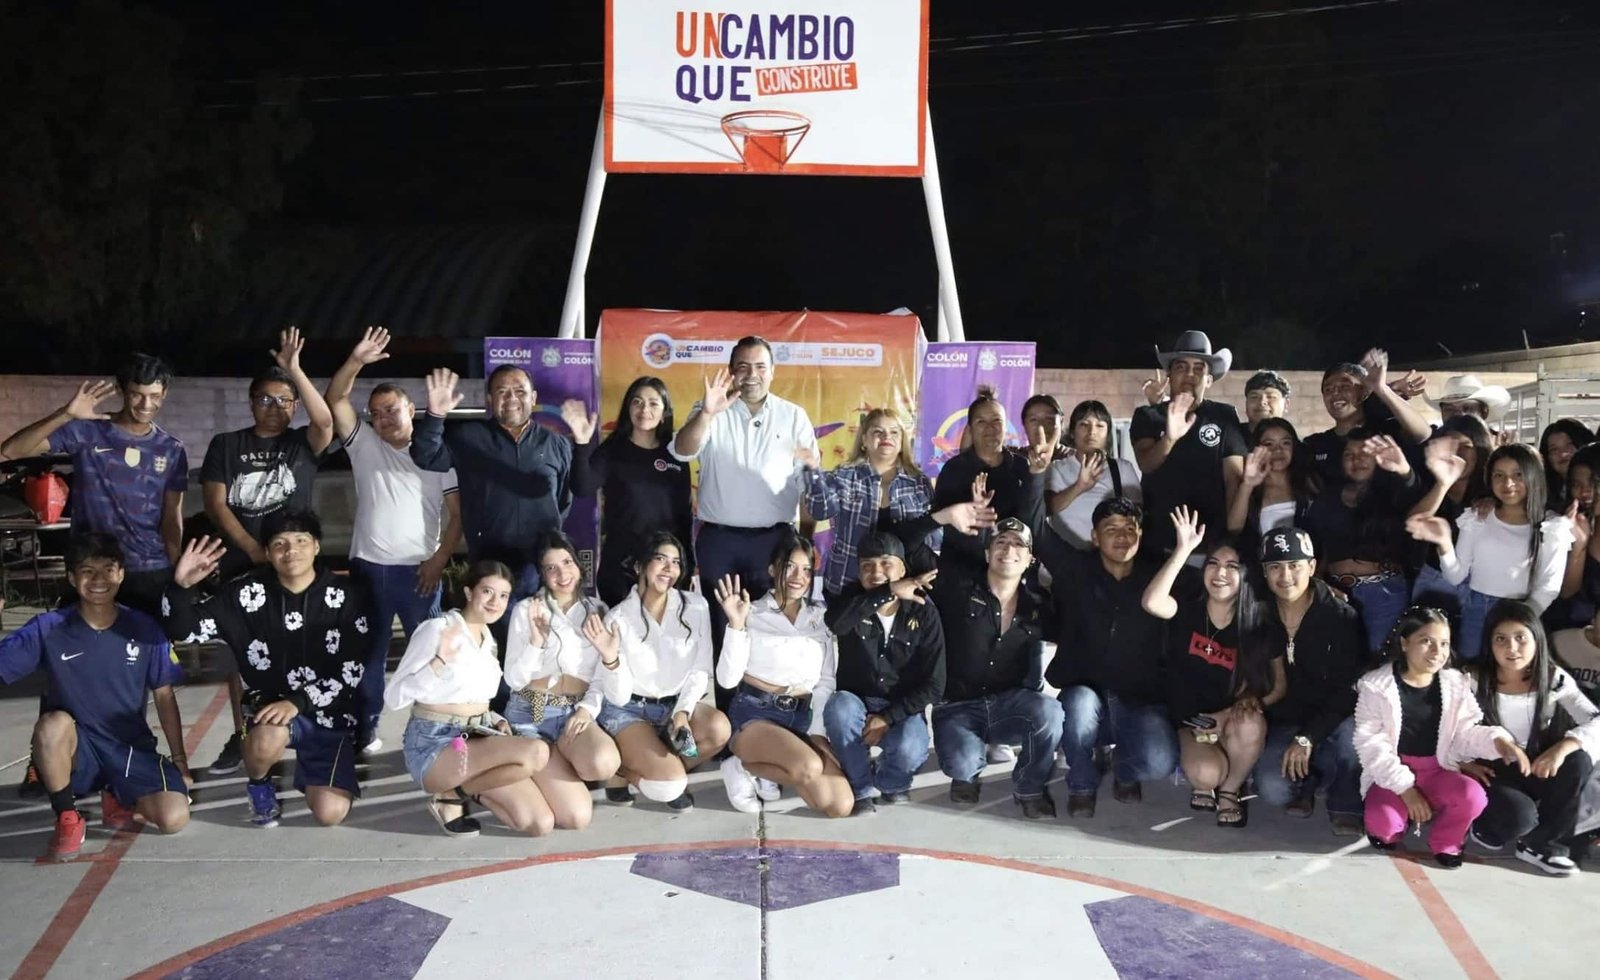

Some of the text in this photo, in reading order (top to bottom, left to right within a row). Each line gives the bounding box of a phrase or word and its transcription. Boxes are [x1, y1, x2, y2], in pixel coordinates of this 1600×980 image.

[676, 11, 855, 61] UN CAMBIO
[675, 64, 852, 104] QUE CONSTRUYE
[686, 345, 724, 353] CAMBIO
[821, 347, 875, 357] SEJUCO
[675, 351, 693, 359] QUE
